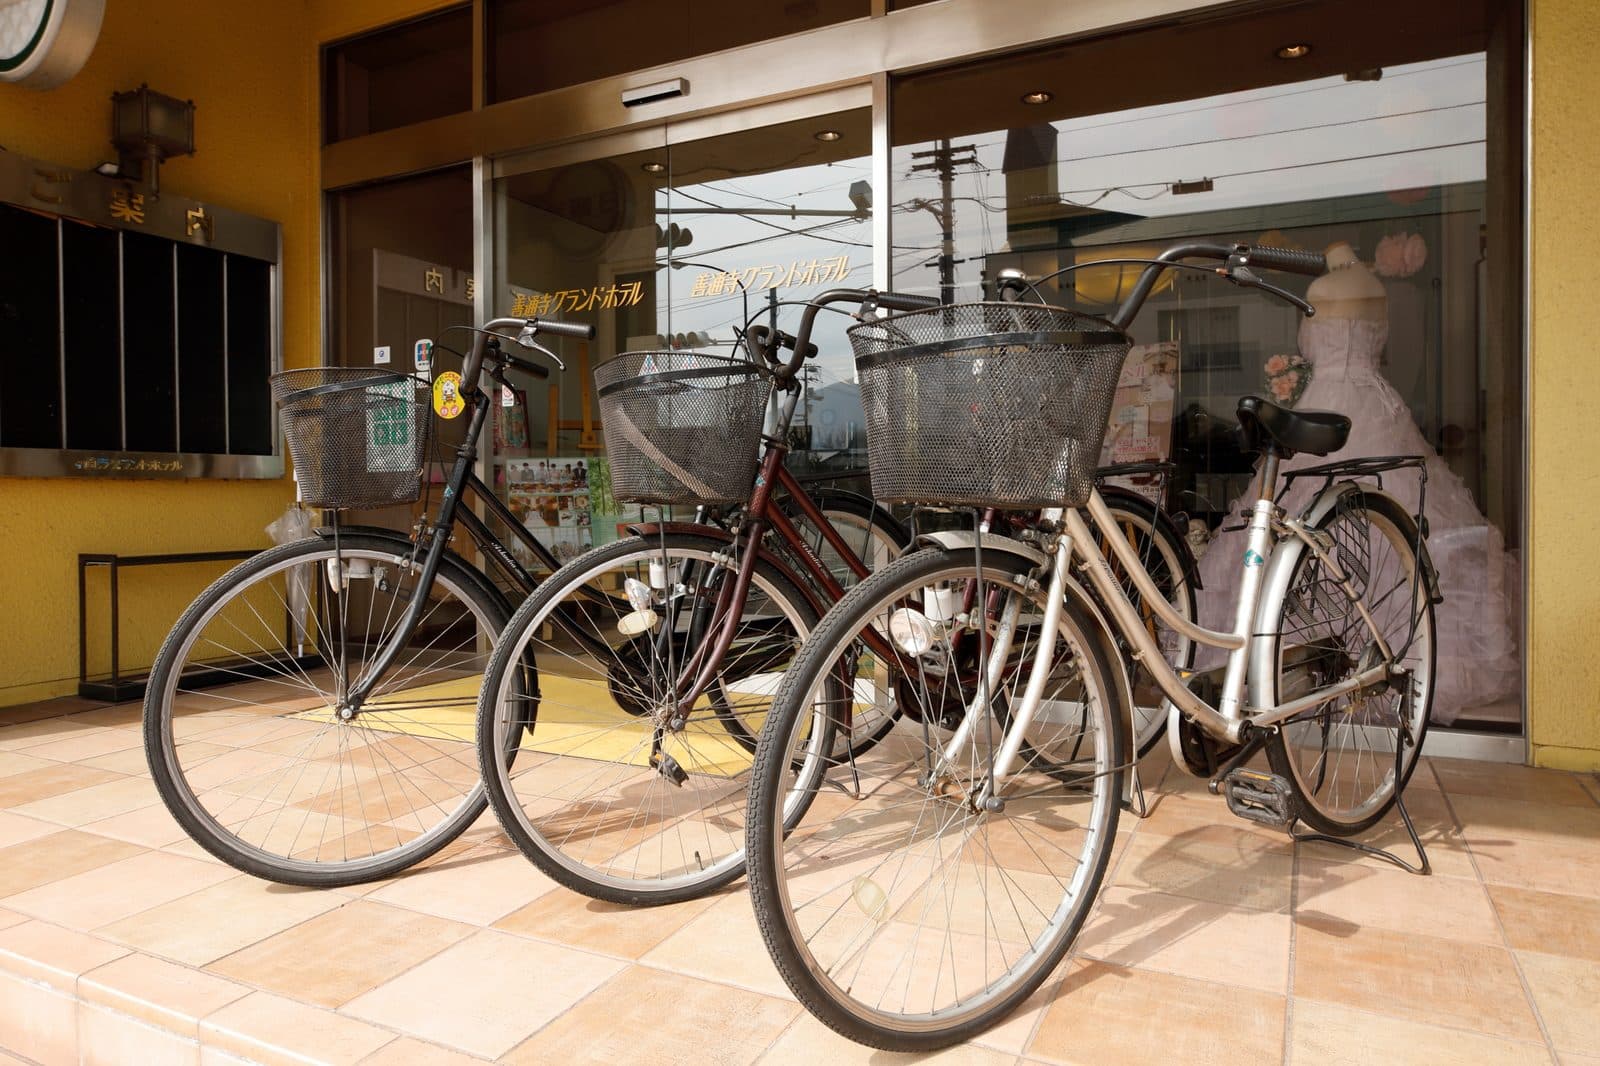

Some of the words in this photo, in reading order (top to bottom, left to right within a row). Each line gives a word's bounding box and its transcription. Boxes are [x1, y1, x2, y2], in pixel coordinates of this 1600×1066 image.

[691, 255, 849, 298] 善通寺グランドホテル
[511, 281, 644, 318] 善通寺グランドホテル
